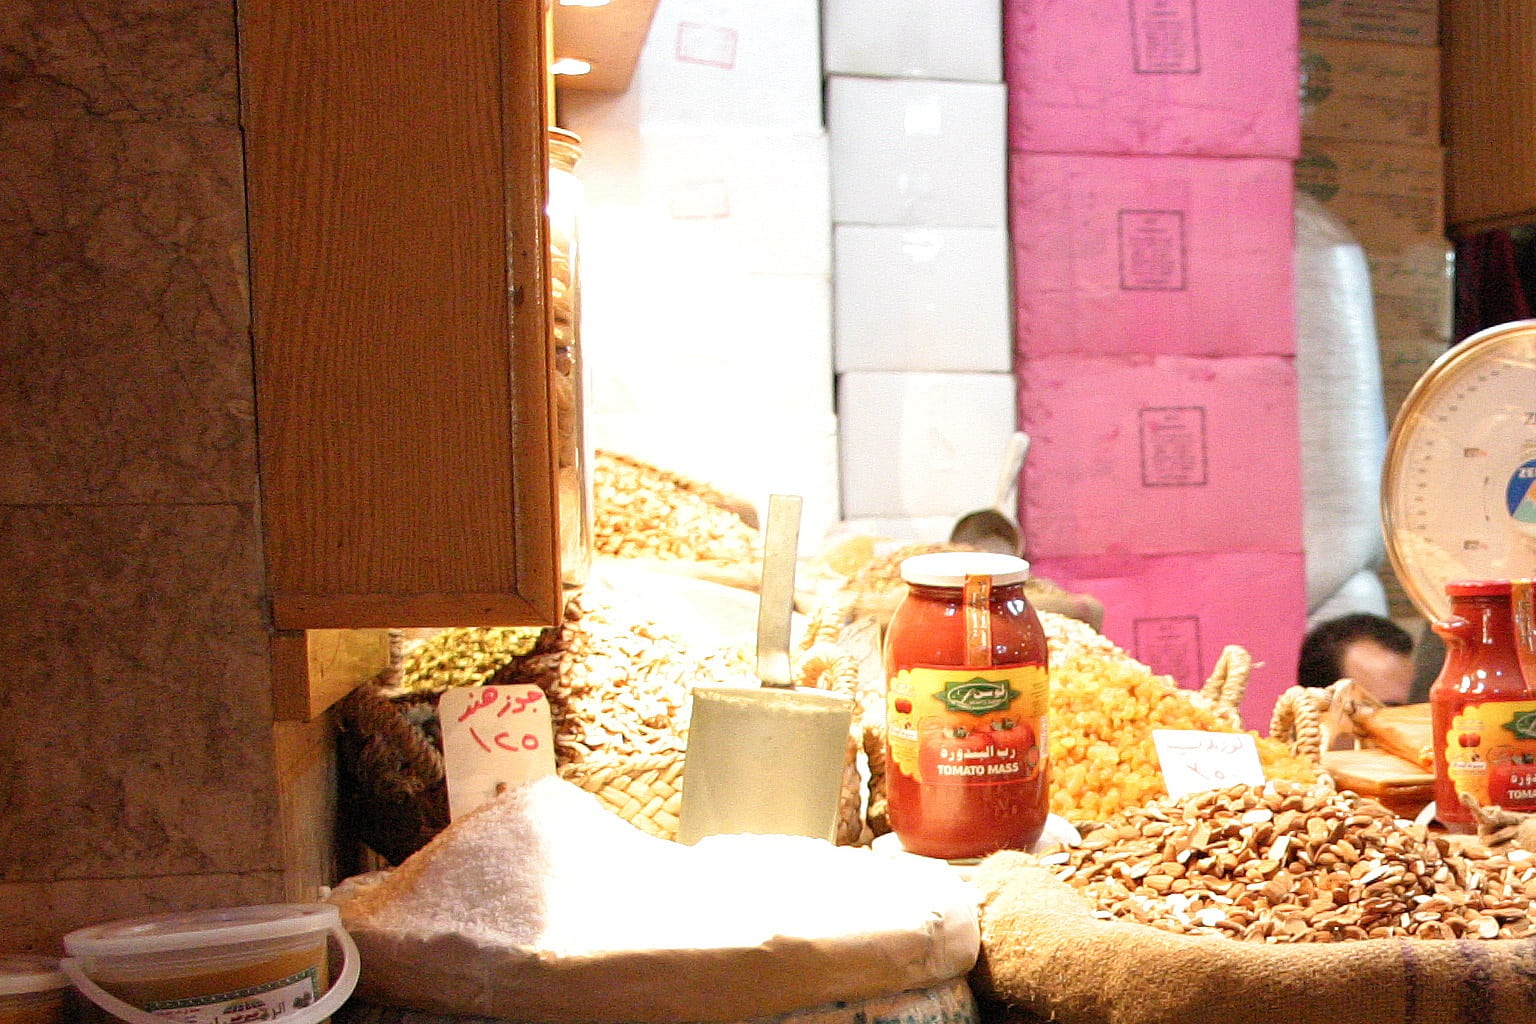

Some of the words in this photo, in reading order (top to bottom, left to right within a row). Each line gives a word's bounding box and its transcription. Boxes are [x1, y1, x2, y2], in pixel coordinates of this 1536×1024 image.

[497, 691, 543, 718] جوز
[996, 747, 1016, 760] رب
[937, 764, 985, 776] TOMATO
[987, 762, 1020, 775] MASS
